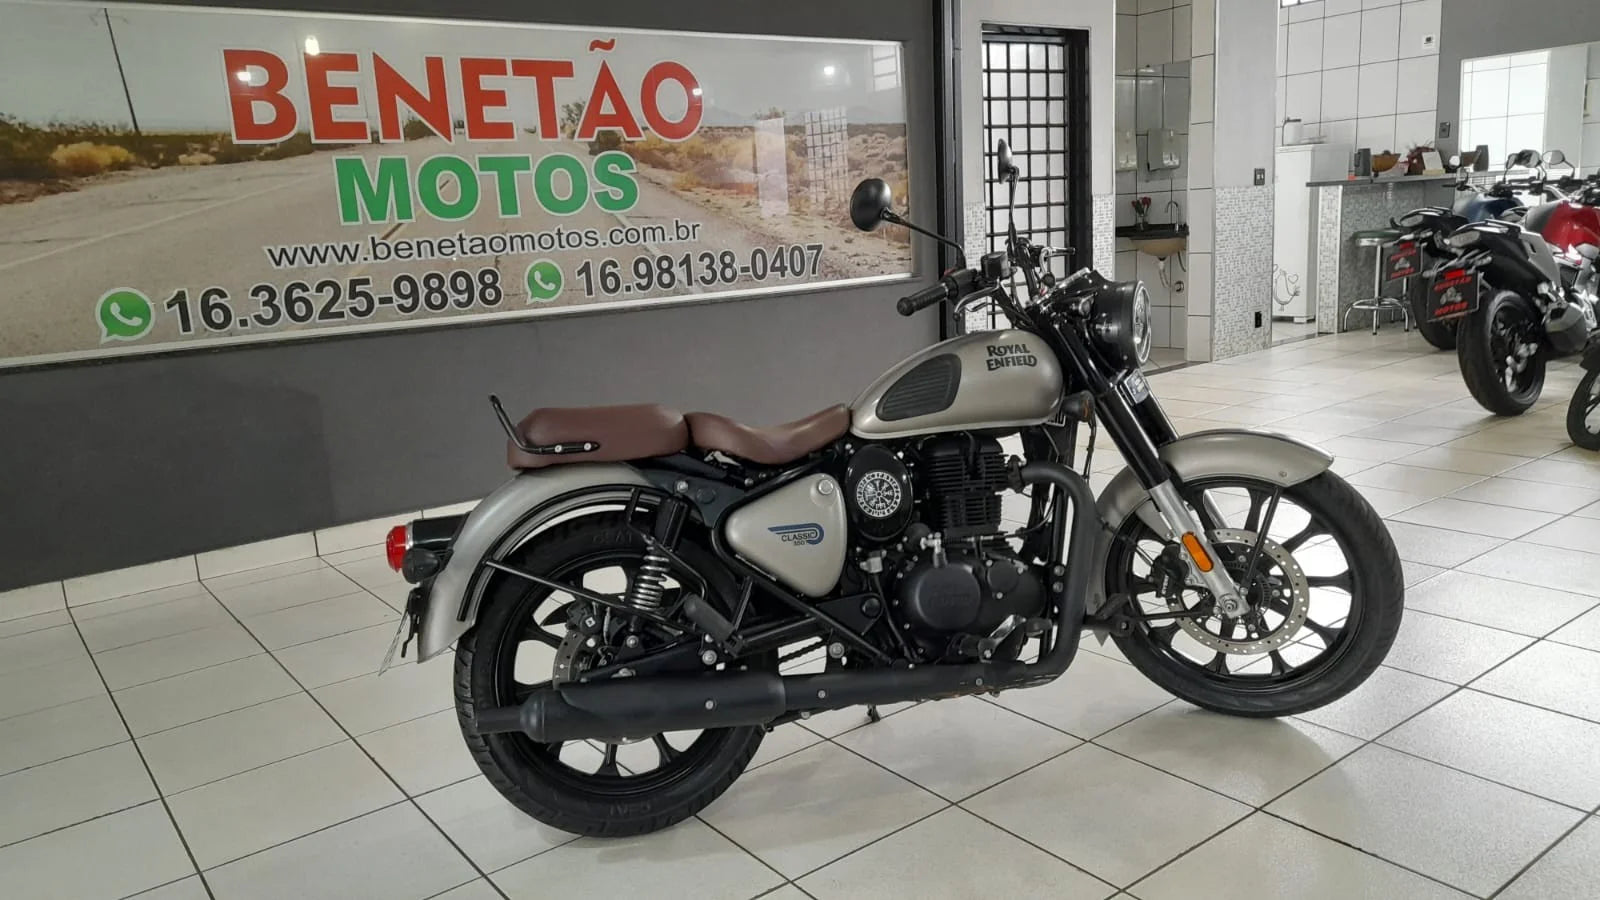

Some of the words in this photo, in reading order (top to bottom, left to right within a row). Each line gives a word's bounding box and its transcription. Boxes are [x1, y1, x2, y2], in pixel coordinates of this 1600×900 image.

[223, 39, 704, 144] BENETÃO
[334, 151, 640, 224] MOTOS
[266, 220, 701, 267] www.benetaomotos.com.br
[577, 245, 823, 296] 16.98138-0407
[166, 269, 503, 332] 16.3625-9898
[986, 343, 1030, 357] ROYAL
[986, 355, 1037, 371] ENFIELD
[781, 531, 816, 542] CLASSIC
